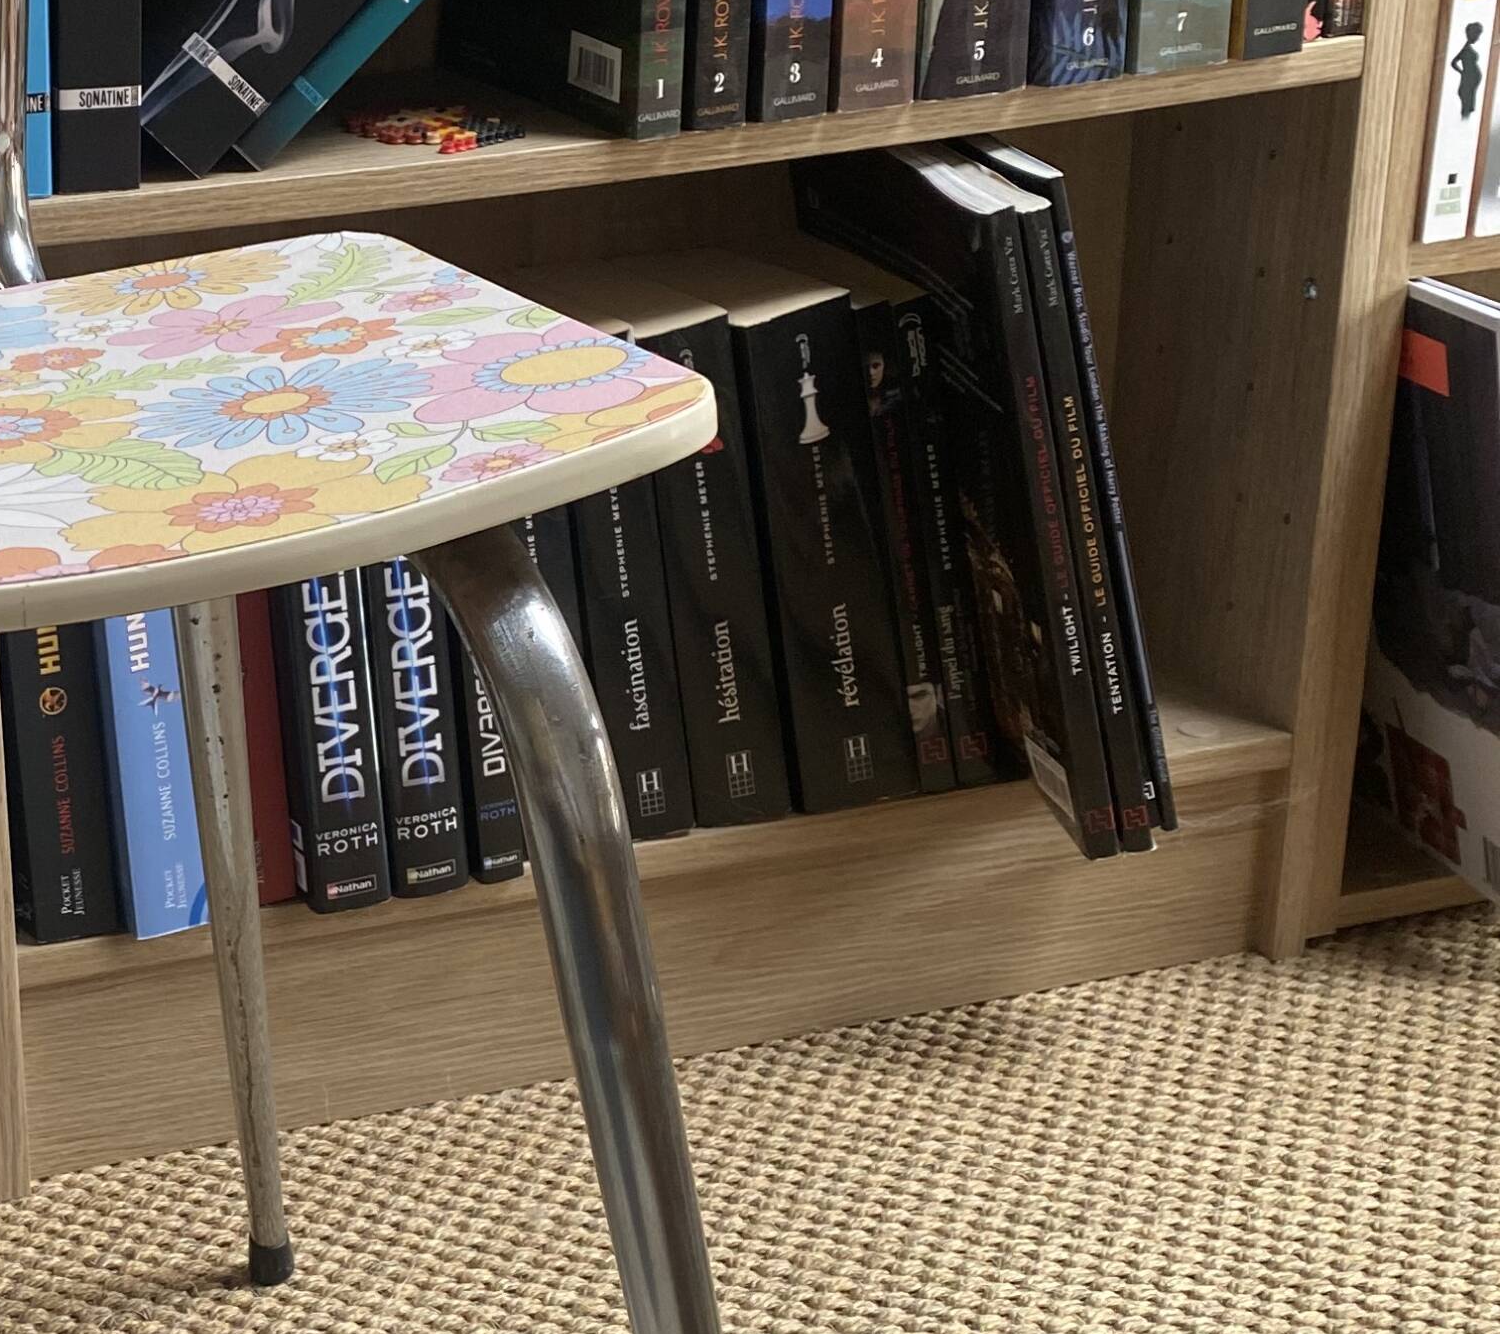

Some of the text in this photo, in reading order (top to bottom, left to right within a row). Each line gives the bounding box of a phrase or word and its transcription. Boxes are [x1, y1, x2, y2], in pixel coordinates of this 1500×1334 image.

[1177, 12, 1188, 32] 7
[1082, 27, 1095, 46] 6
[870, 47, 885, 68] 4
[973, 40, 986, 61] 5
[713, 72, 725, 94] 2
[789, 62, 801, 84] 3
[78, 88, 130, 108] SONATINE
[227, 74, 262, 110] SONATINE
[656, 78, 665, 99] 1
[812, 445, 836, 565] STEPHENIE MEYER
[695, 461, 718, 581] STEPHENIE MEYER
[614, 527, 630, 598] STEPHENIE
[1064, 395, 1124, 715] TENTATION LE GUIDE OFFICIEL DU FILM
[1061, 606, 1084, 676] TWILIGHT
[831, 603, 860, 708] révélation
[621, 618, 651, 731] fascination
[712, 620, 741, 723] hésitation
[730, 753, 749, 774] H
[152, 721, 177, 841] SUZANNE COLLINS
[640, 771, 660, 792] H
[51, 735, 76, 855] SUZANNE COLLINS
[395, 806, 458, 825] VERONICA
[315, 822, 378, 841] VERONICA
[397, 817, 458, 841] ROTH
[317, 832, 379, 858] ROTH
